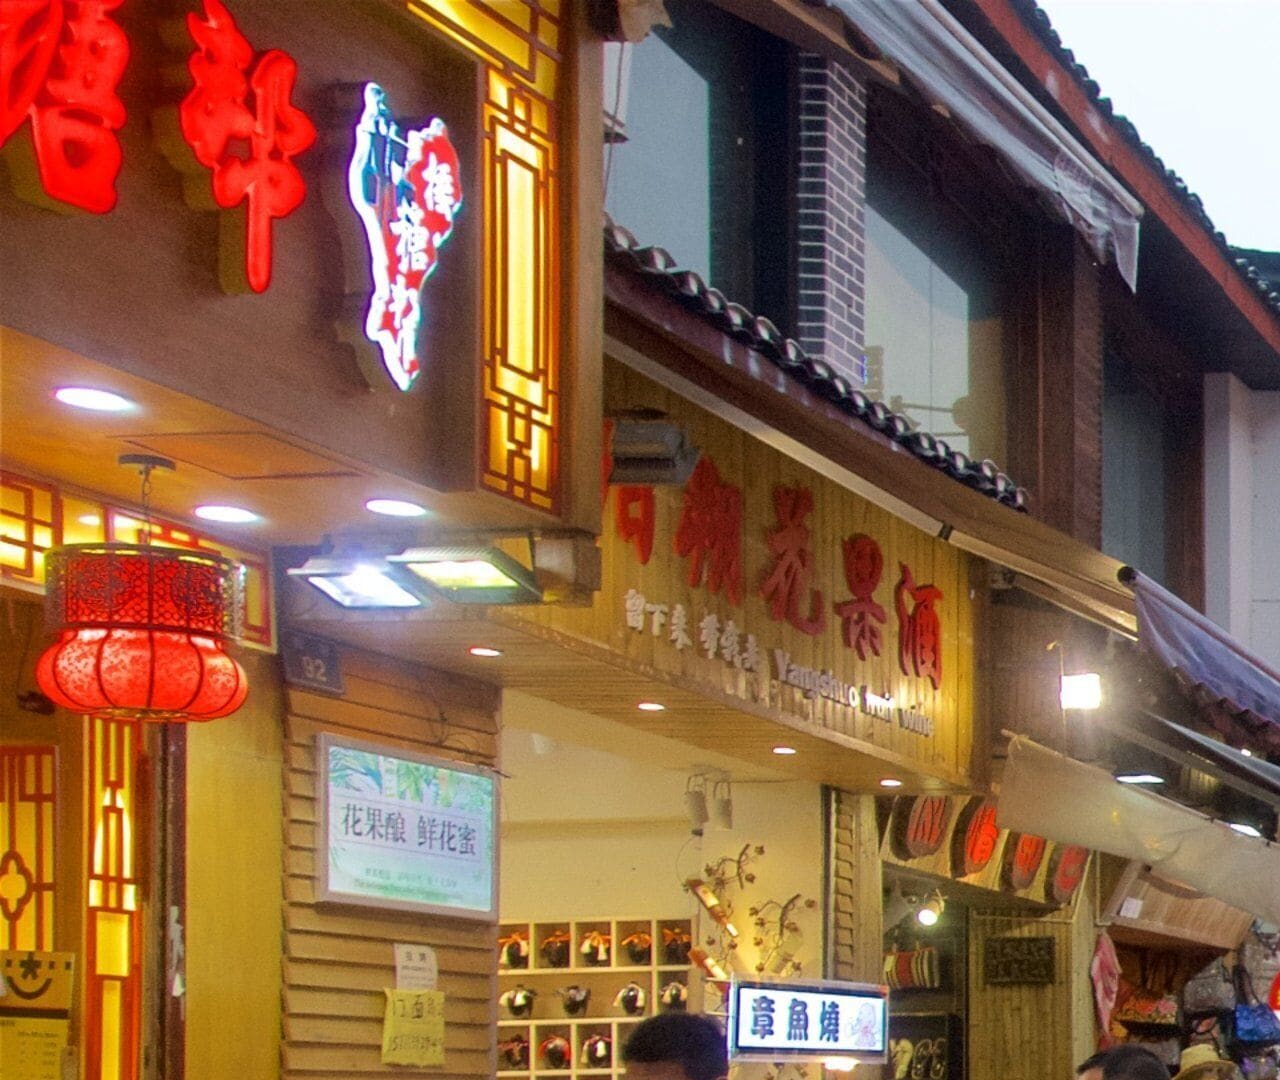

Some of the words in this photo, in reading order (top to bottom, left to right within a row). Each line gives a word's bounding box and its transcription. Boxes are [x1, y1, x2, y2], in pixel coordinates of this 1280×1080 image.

[774, 649, 861, 708] Yangshuo
[341, 803, 406, 844] 花果酿
[417, 815, 477, 856] 鲜花蜜
